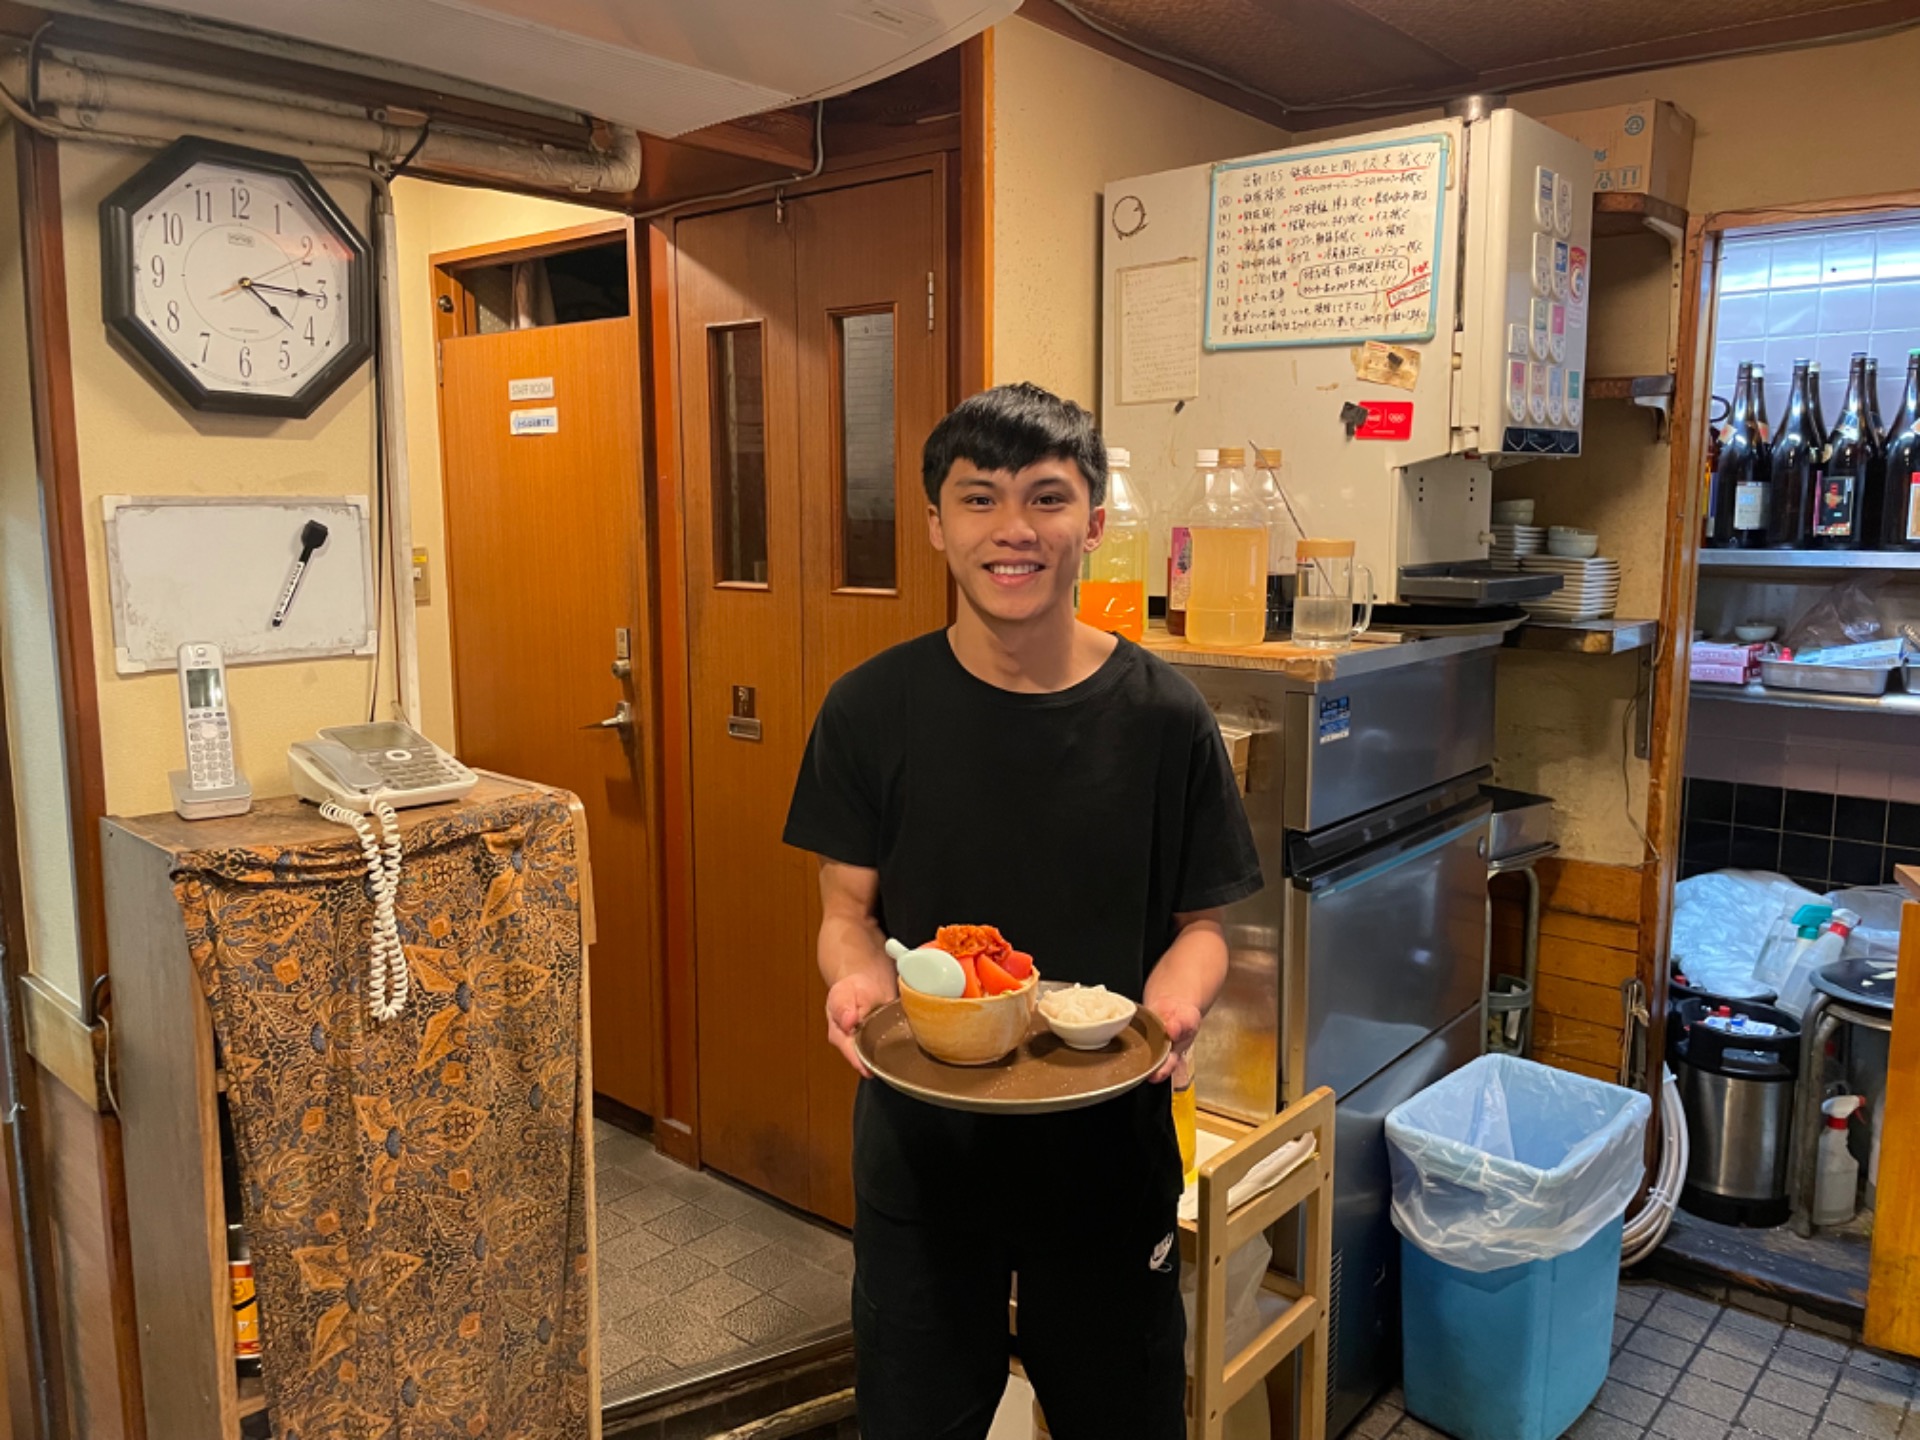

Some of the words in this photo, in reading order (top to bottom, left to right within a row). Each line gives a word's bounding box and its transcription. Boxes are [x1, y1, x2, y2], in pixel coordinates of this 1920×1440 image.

[194, 189, 213, 223] 11
[230, 186, 250, 220] 12
[273, 203, 281, 235] 1
[161, 212, 184, 246] 10
[301, 235, 313, 266] 2
[151, 254, 165, 288] 9
[315, 279, 328, 310] 3
[167, 300, 180, 333] 8
[303, 316, 315, 347] 4
[199, 332, 210, 363] 7
[239, 346, 252, 378] 6
[278, 340, 290, 370] 5
